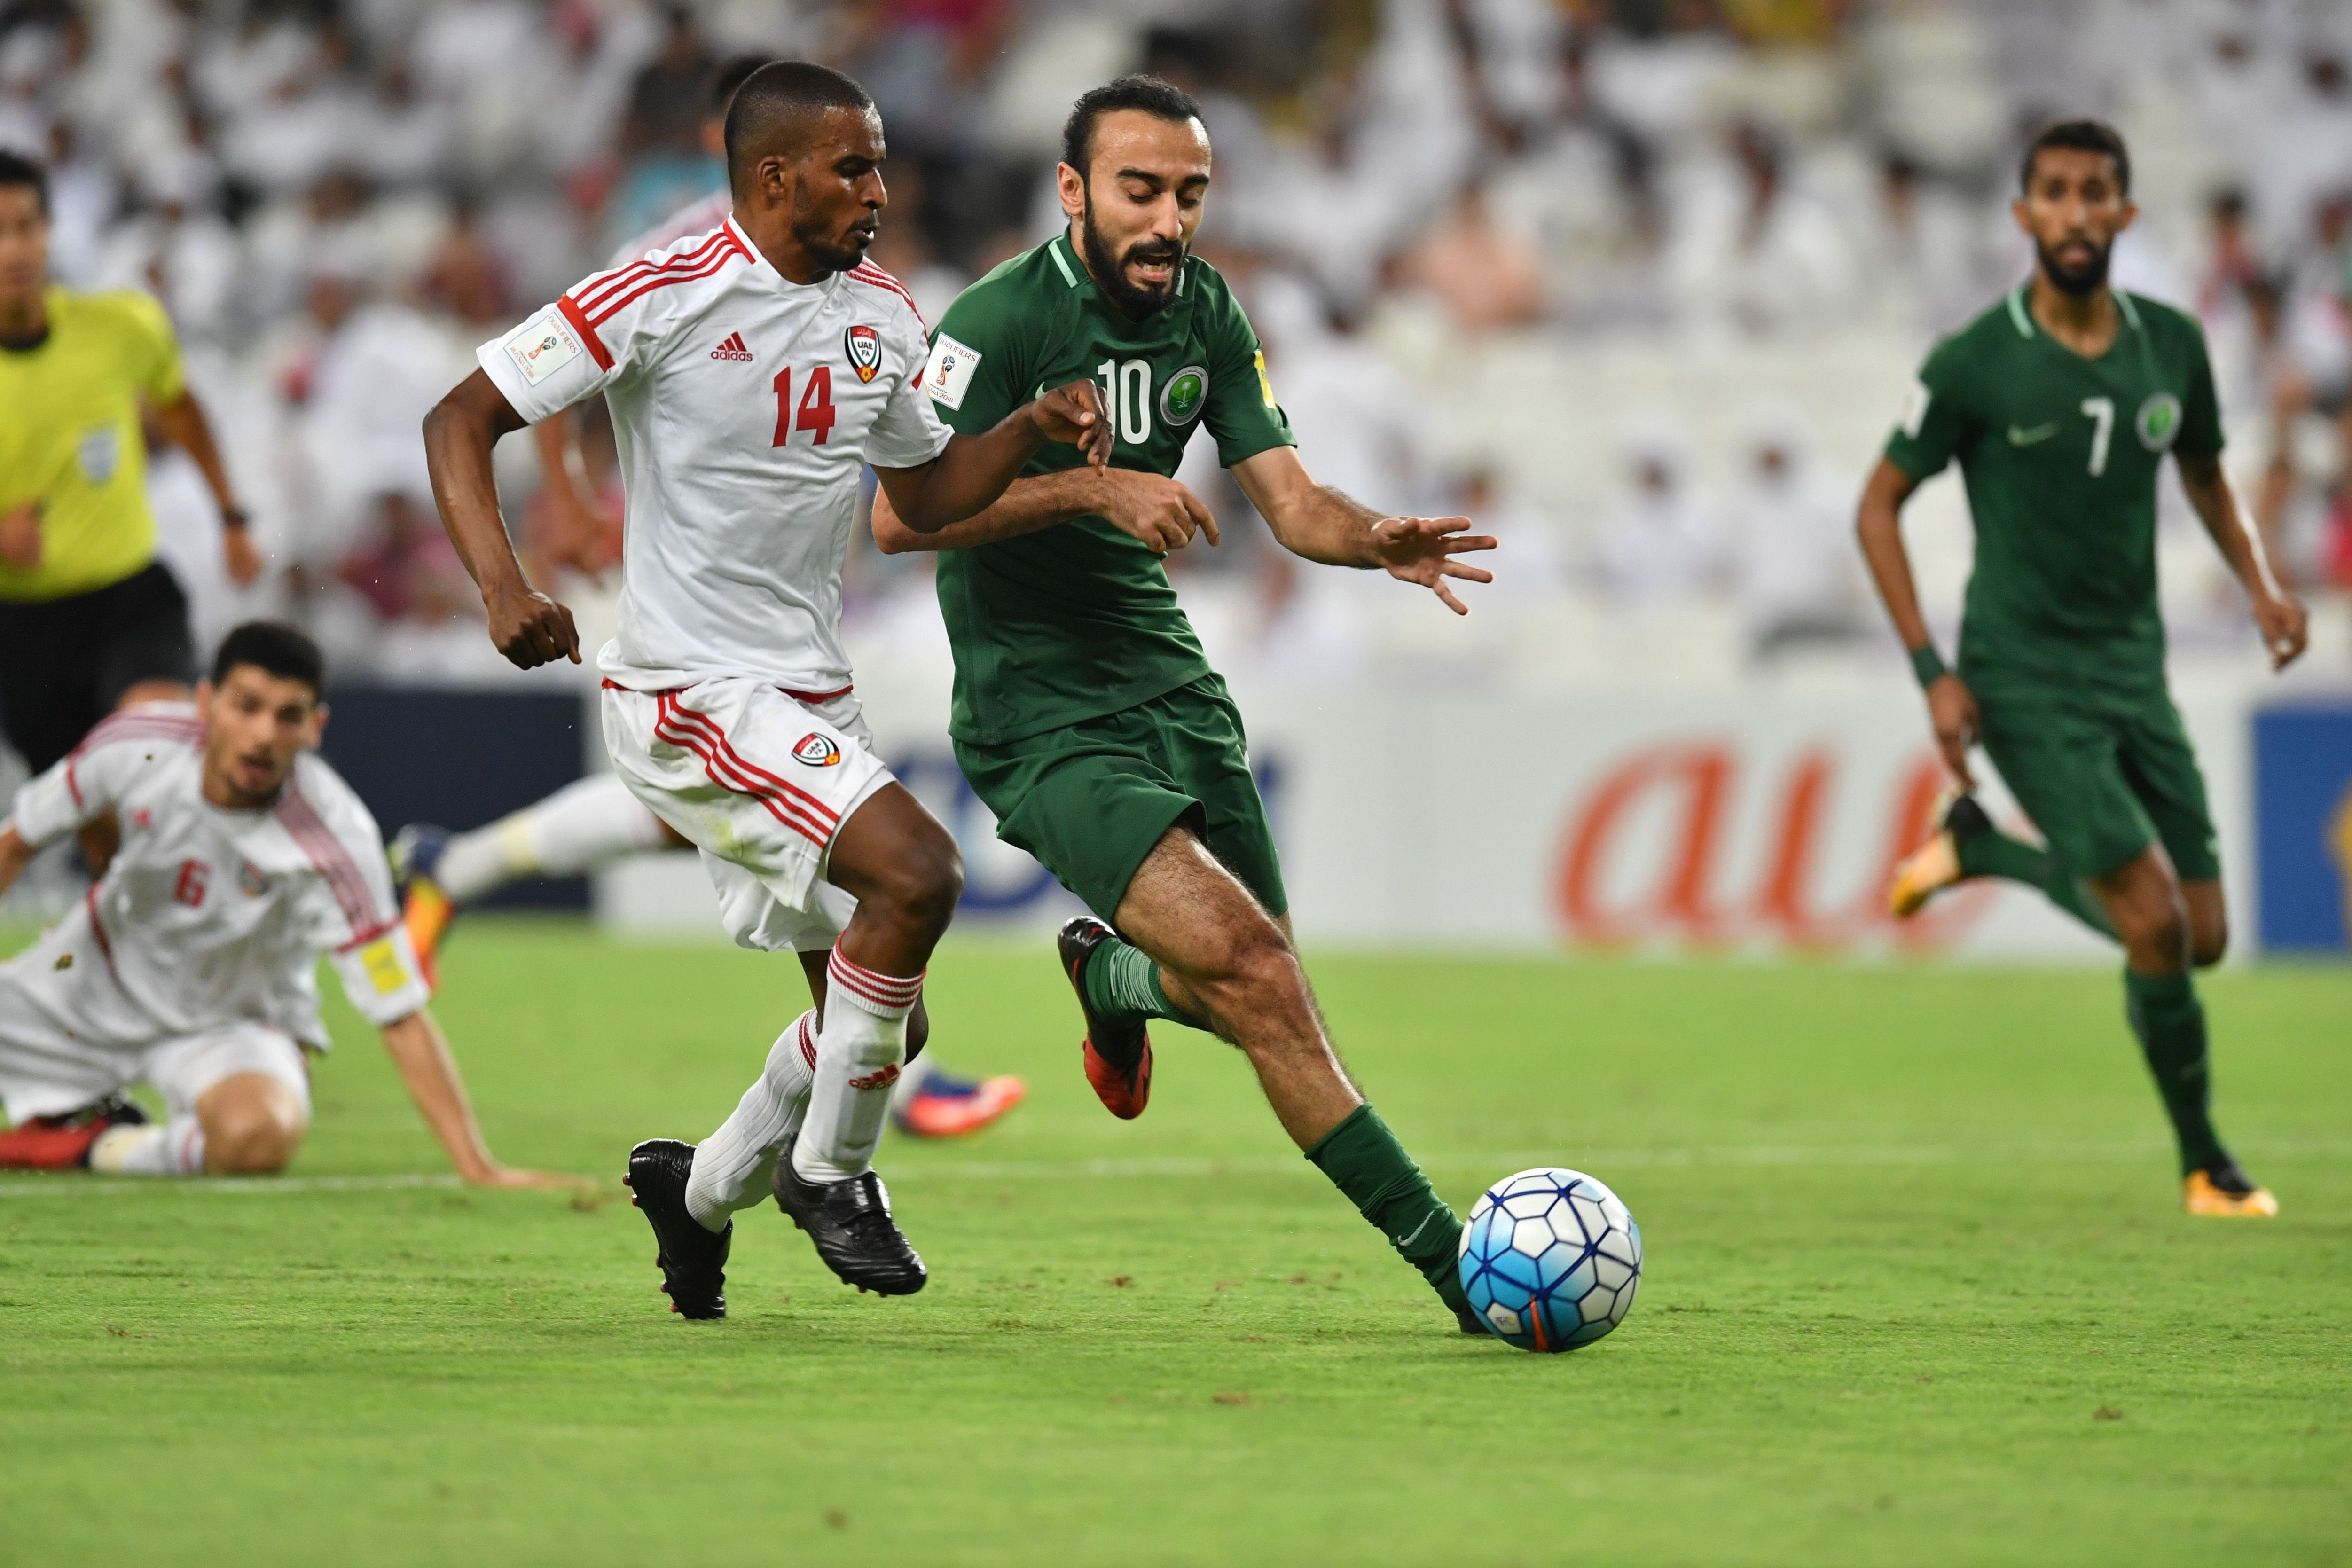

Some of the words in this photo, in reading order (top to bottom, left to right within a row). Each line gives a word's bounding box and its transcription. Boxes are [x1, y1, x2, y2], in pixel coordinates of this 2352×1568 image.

[548, 316, 578, 353] QUALIFIERS
[857, 341, 873, 350] UAE
[939, 337, 976, 362] QUALIFIERS
[711, 349, 753, 362] adidas
[772, 366, 835, 447] 14
[927, 386, 939, 396] SSIA
[939, 393, 953, 403] 2018
[1098, 359, 1151, 444] 10
[2080, 398, 2115, 477] 7
[175, 859, 210, 907] 6
